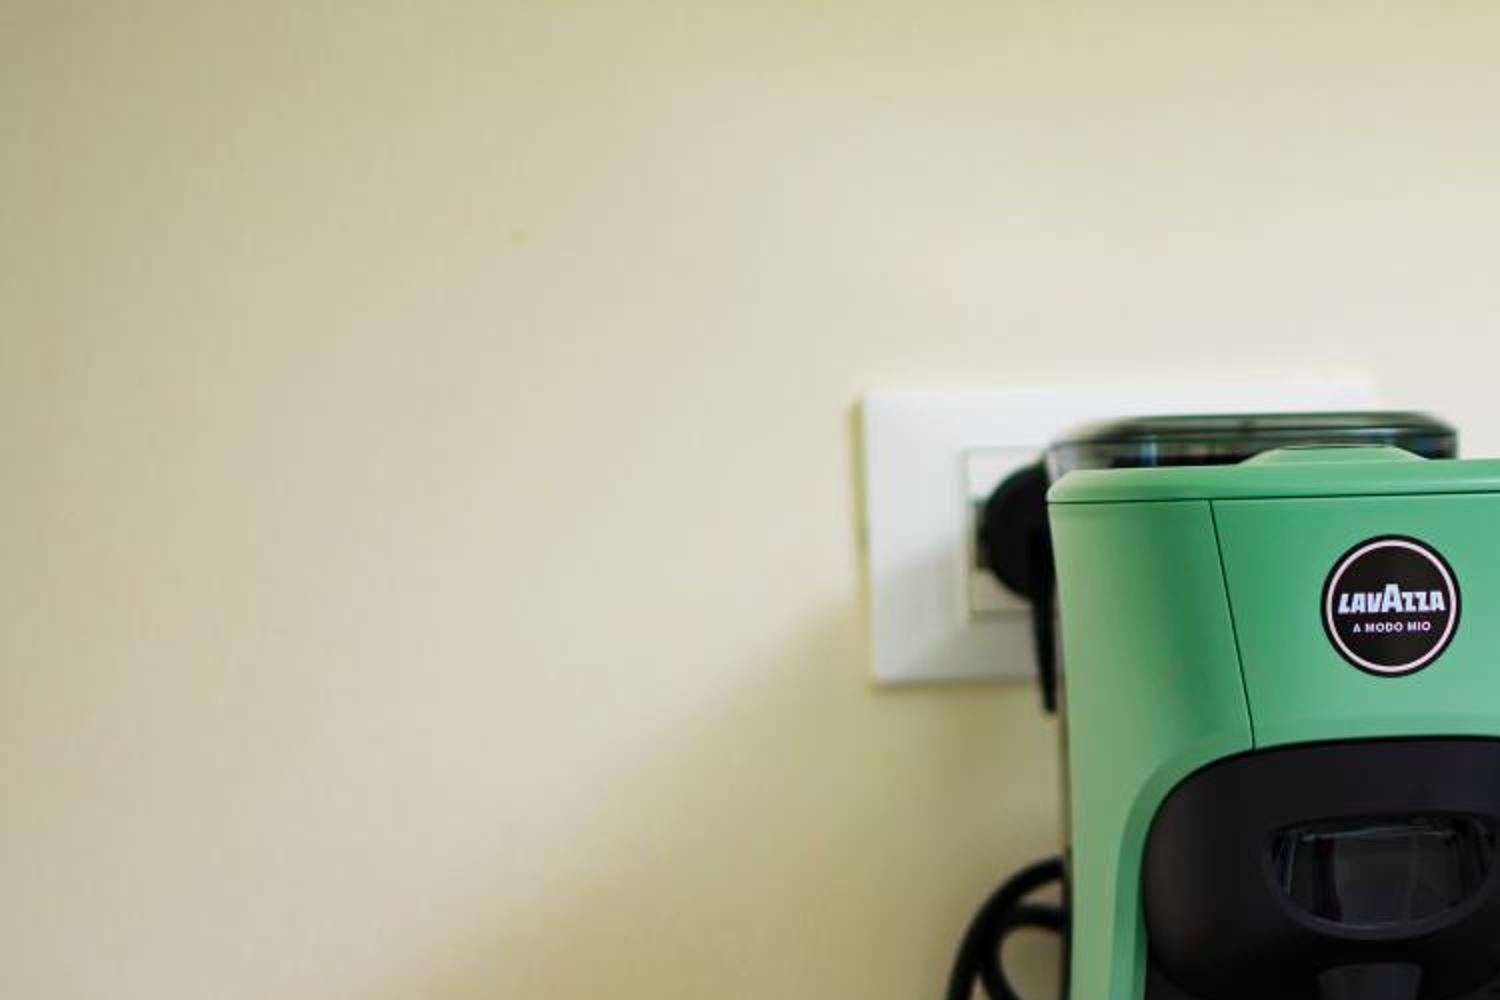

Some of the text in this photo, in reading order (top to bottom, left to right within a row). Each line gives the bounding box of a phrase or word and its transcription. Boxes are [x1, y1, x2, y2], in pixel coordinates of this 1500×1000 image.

[1338, 583, 1446, 614] LAVAZZA
[1353, 621, 1431, 633] A MODO MIO
